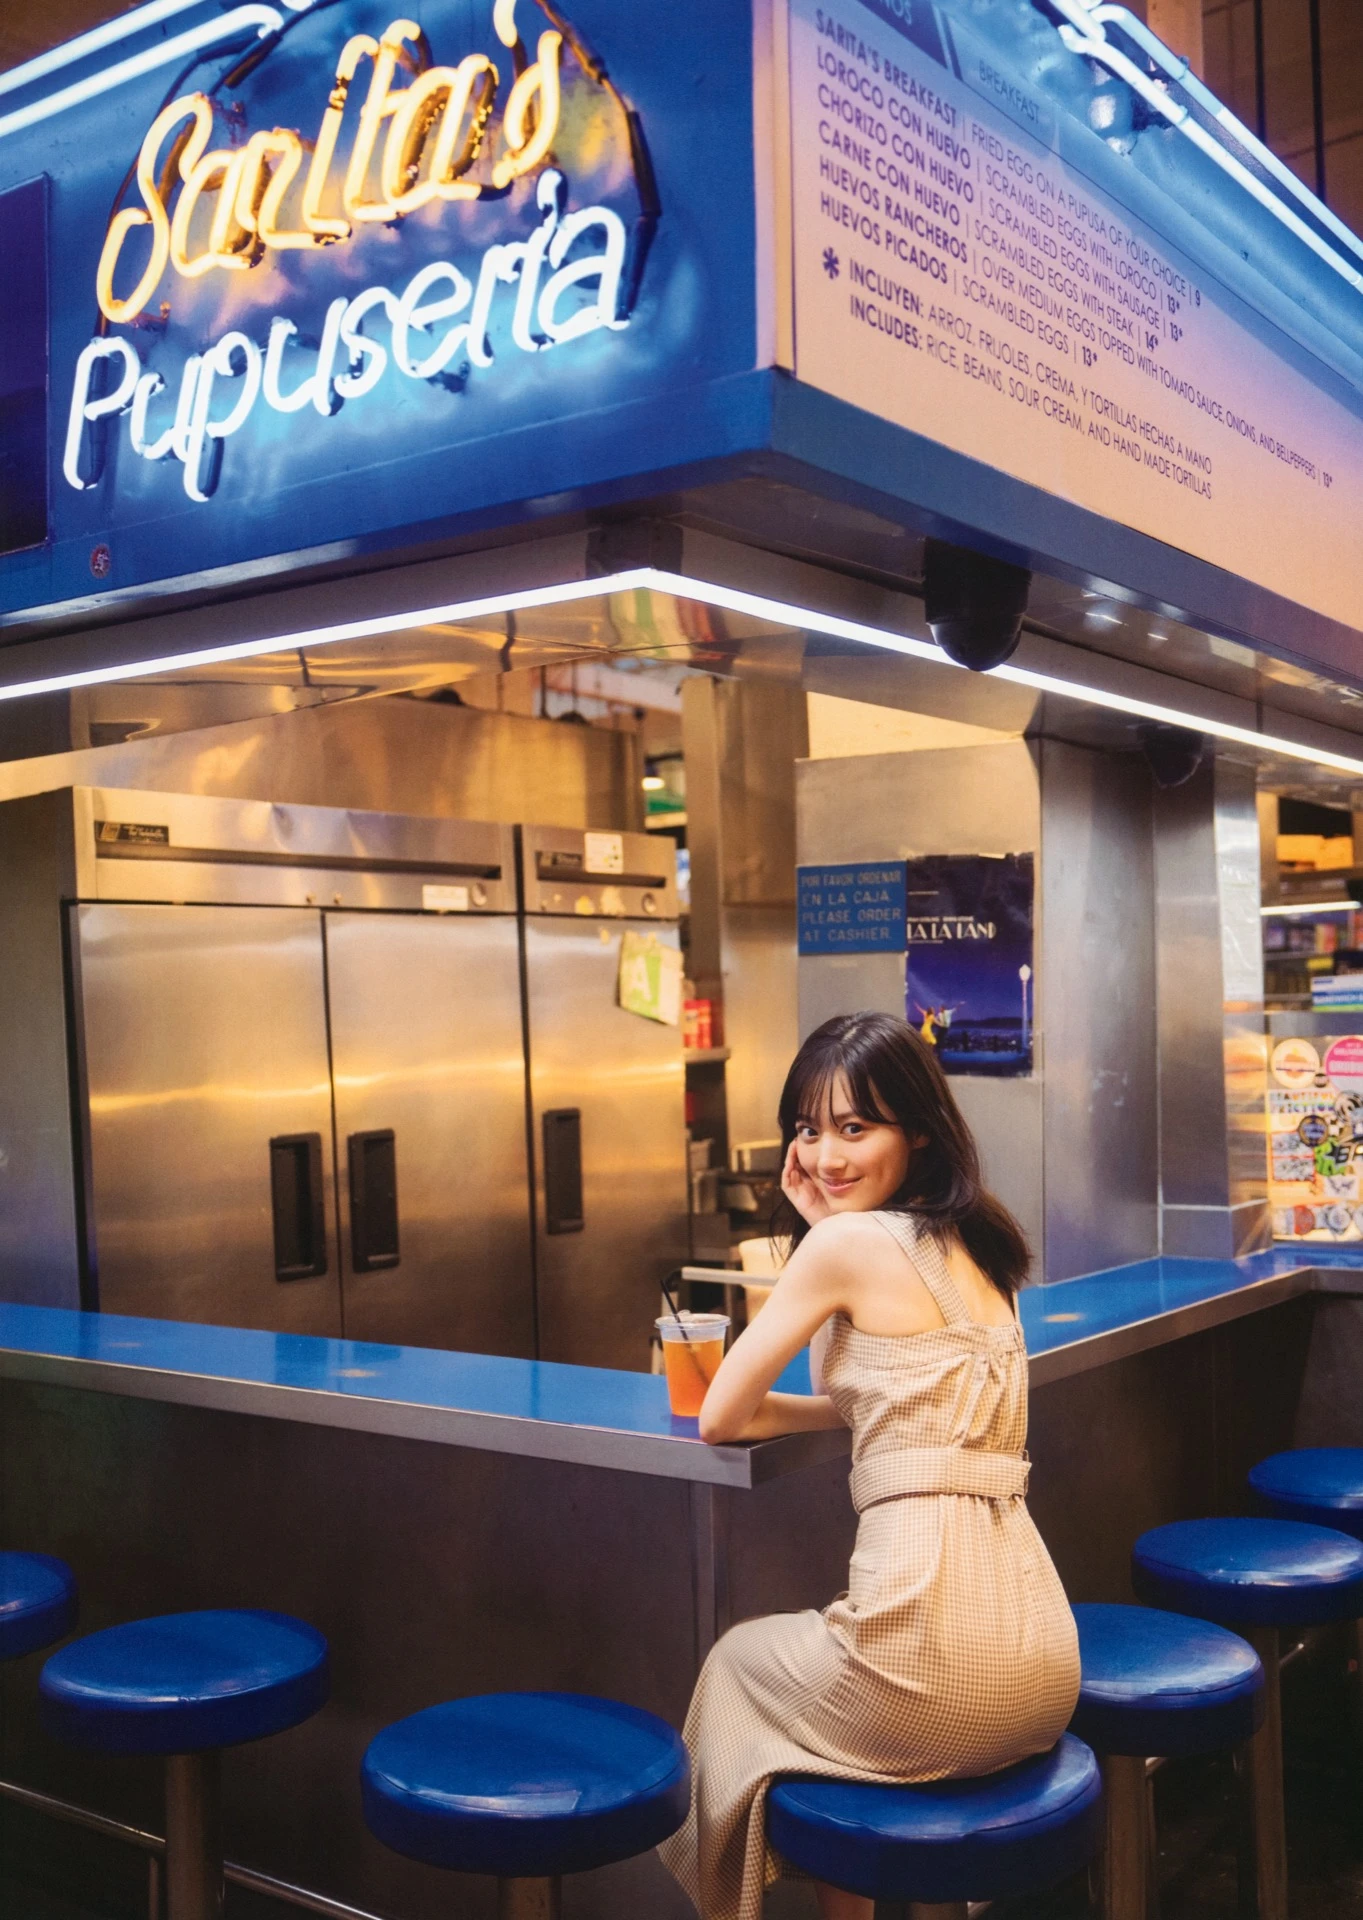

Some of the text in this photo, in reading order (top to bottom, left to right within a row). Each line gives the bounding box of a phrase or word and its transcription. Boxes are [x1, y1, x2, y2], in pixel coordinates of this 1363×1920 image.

[97, 0, 563, 323] Sarita's
[816, 8, 1201, 307] SARITA'S BREAKFAST FRIED EGG ON A PUPUSA OF YOUR CHOICE 9
[817, 45, 884, 110] LOROCO
[888, 97, 922, 138] CON
[926, 121, 971, 170] HUEVO
[985, 164, 1055, 229] SCRAMBLED
[1057, 215, 1087, 252] EGGS
[1089, 237, 1113, 270] WITH
[1115, 256, 1157, 300] LOROCO
[979, 60, 1040, 125] BREAKFAST
[818, 83, 887, 146] CHORIZO
[891, 133, 925, 173] CON
[929, 156, 974, 203] HUEVO
[988, 197, 1058, 259] SCRAMBLED
[1060, 246, 1090, 282] EGGS
[1092, 267, 1116, 300] WITH
[1117, 285, 1160, 330] SAUSAGE
[818, 120, 871, 172] CARNE
[875, 156, 910, 196] CON
[914, 179, 960, 226] HUEVO
[975, 219, 1045, 281] SCRAMBLED
[1048, 267, 1078, 303] EGGS
[1081, 288, 1105, 320] WITH
[1106, 305, 1134, 339] STEAK
[820, 190, 881, 246] HUEVOS
[885, 229, 948, 284] PICADOS
[963, 275, 1035, 334] SCRAMBLED
[1038, 319, 1069, 355] EGGS
[820, 155, 880, 211] HUEVOS
[885, 195, 968, 264] RANCHEROS
[982, 256, 1015, 293] OVER
[1018, 279, 1064, 322] MEDIUM
[1066, 307, 1096, 342] EGGS
[1098, 327, 1135, 365] TOPPED
[1136, 351, 1158, 381] WITH
[1159, 366, 1195, 404] TOMATO
[1196, 390, 1225, 425] SAUCE,
[1259, 432, 1276, 454] AND
[850, 256, 924, 319] INCLUYEN:
[1035, 362, 1078, 403] CREMA,
[1081, 385, 1088, 406] Y
[1090, 390, 1137, 433] TORTILLAS
[1139, 418, 1175, 454] HECHAS
[1177, 441, 1184, 459] A
[1185, 446, 1212, 475] MANO
[850, 294, 923, 351] INCLUDES:
[964, 352, 1005, 395] BEANS,
[1008, 376, 1040, 411] SOUR
[1043, 395, 1085, 435] CREAM,
[1087, 421, 1111, 447] AND
[1113, 432, 1142, 463] HAND
[1144, 450, 1170, 478] MADE
[1171, 463, 1212, 500] TORTILLAS
[802, 893, 822, 907] EN
[828, 892, 846, 905] LA
[802, 910, 850, 925] PLEASE
[857, 908, 901, 922] ORDER
[804, 929, 820, 942] AT
[907, 921, 996, 939] LA LA LAND
